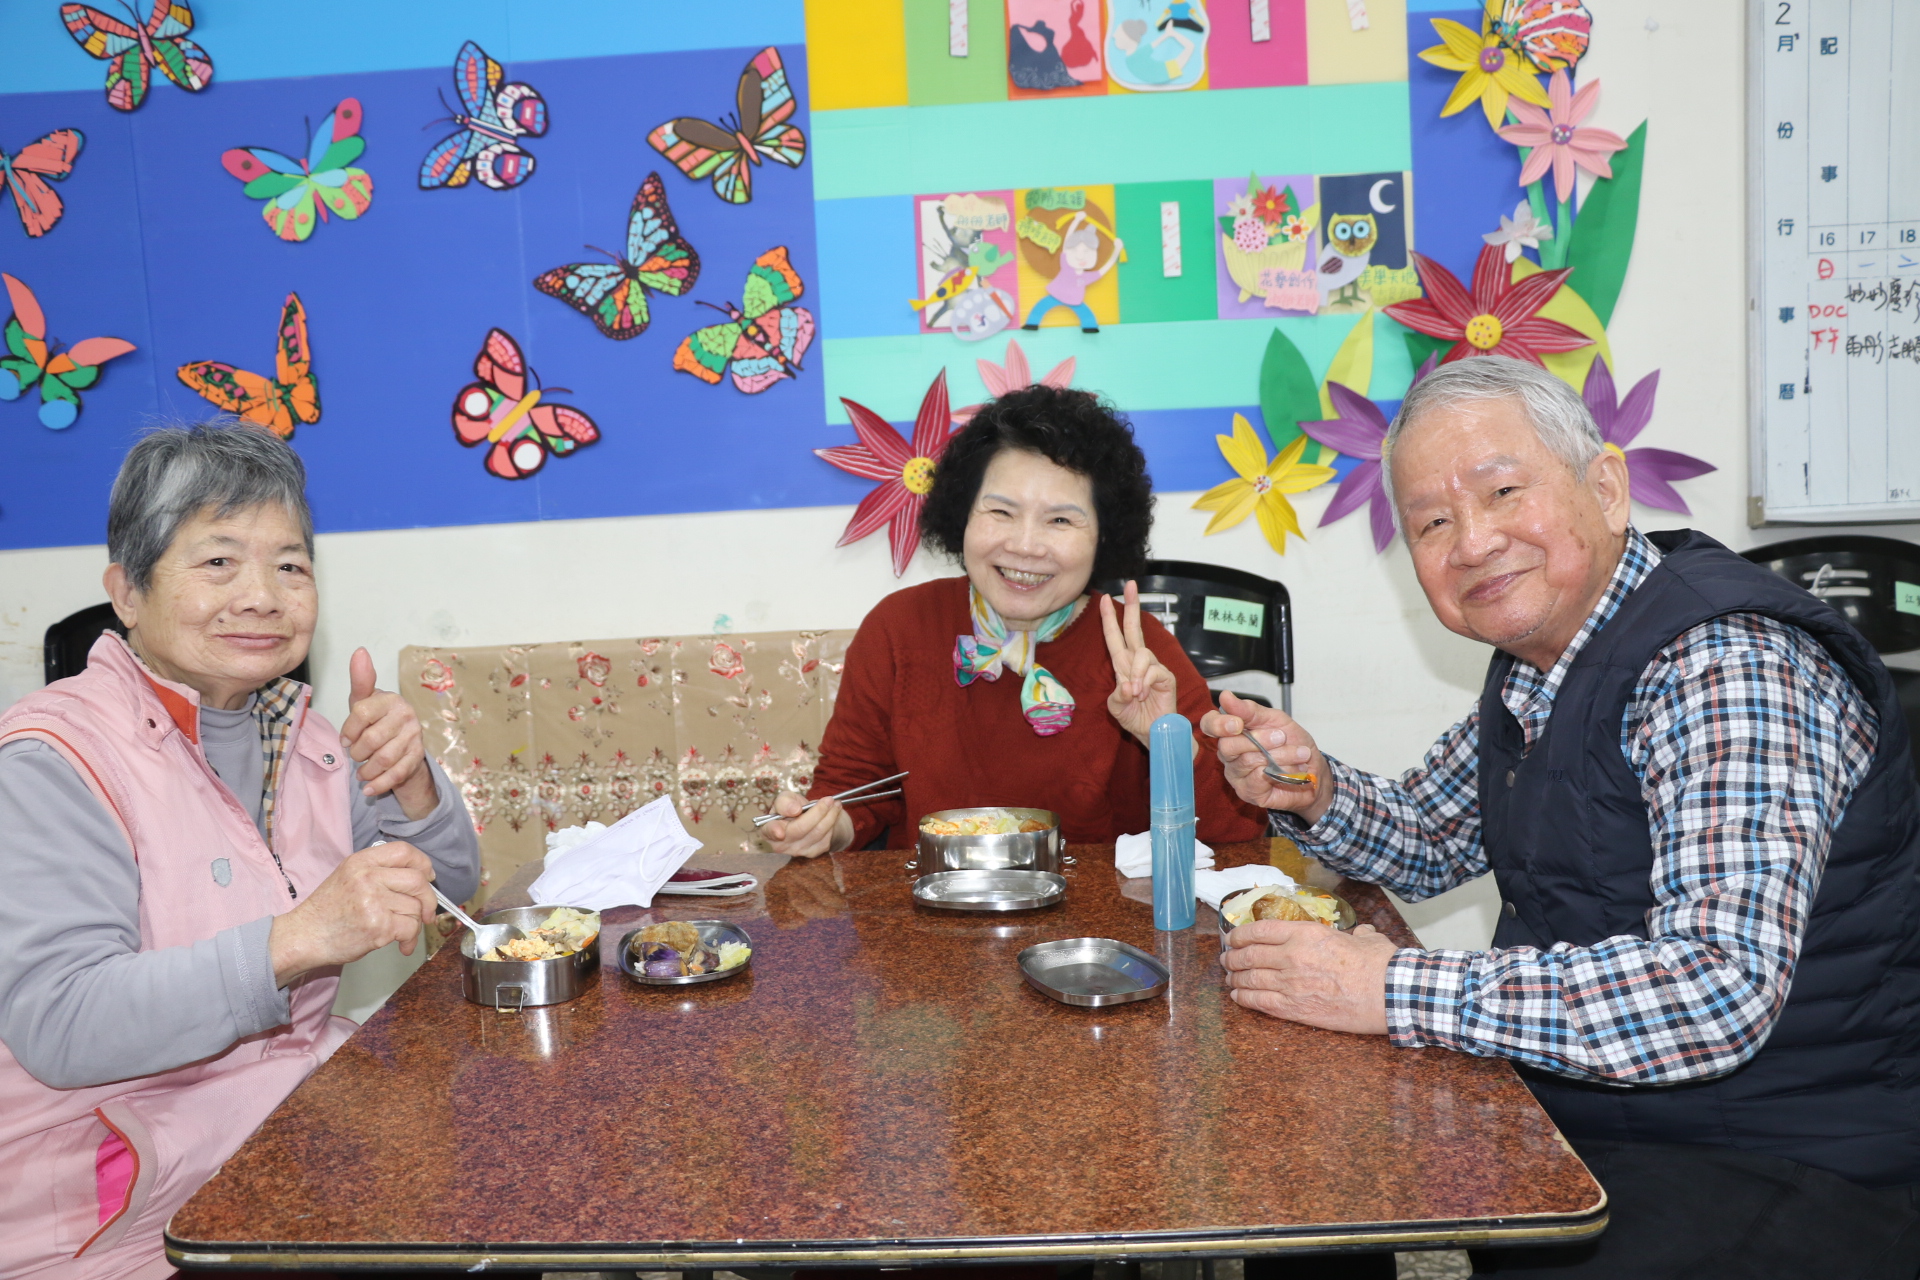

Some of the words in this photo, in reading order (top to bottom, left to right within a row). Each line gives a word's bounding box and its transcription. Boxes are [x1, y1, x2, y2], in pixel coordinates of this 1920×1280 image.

[1820, 232, 1835, 246] 16
[1860, 231, 1876, 244] 17
[1900, 229, 1916, 243] 18
[1208, 608, 1260, 628] 陳林春蘭
